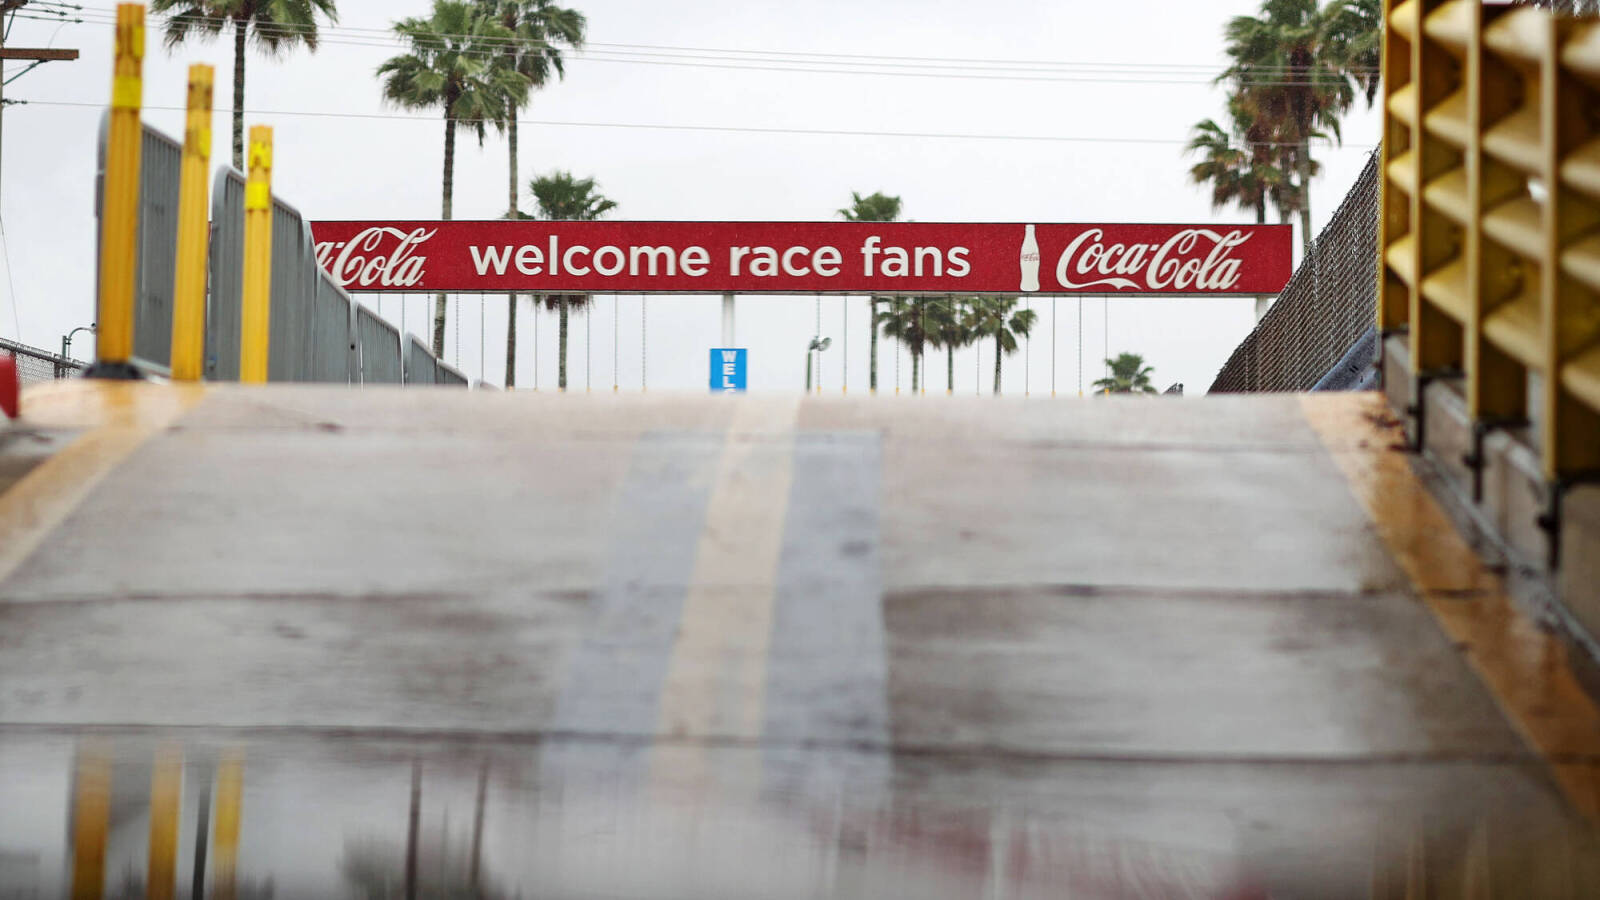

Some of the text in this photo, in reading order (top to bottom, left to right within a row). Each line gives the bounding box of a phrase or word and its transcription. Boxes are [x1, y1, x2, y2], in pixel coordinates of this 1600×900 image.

[469, 234, 971, 278] welcome race fans
[1055, 228, 1254, 290] Coca-Cola
[721, 350, 737, 392] WEL
